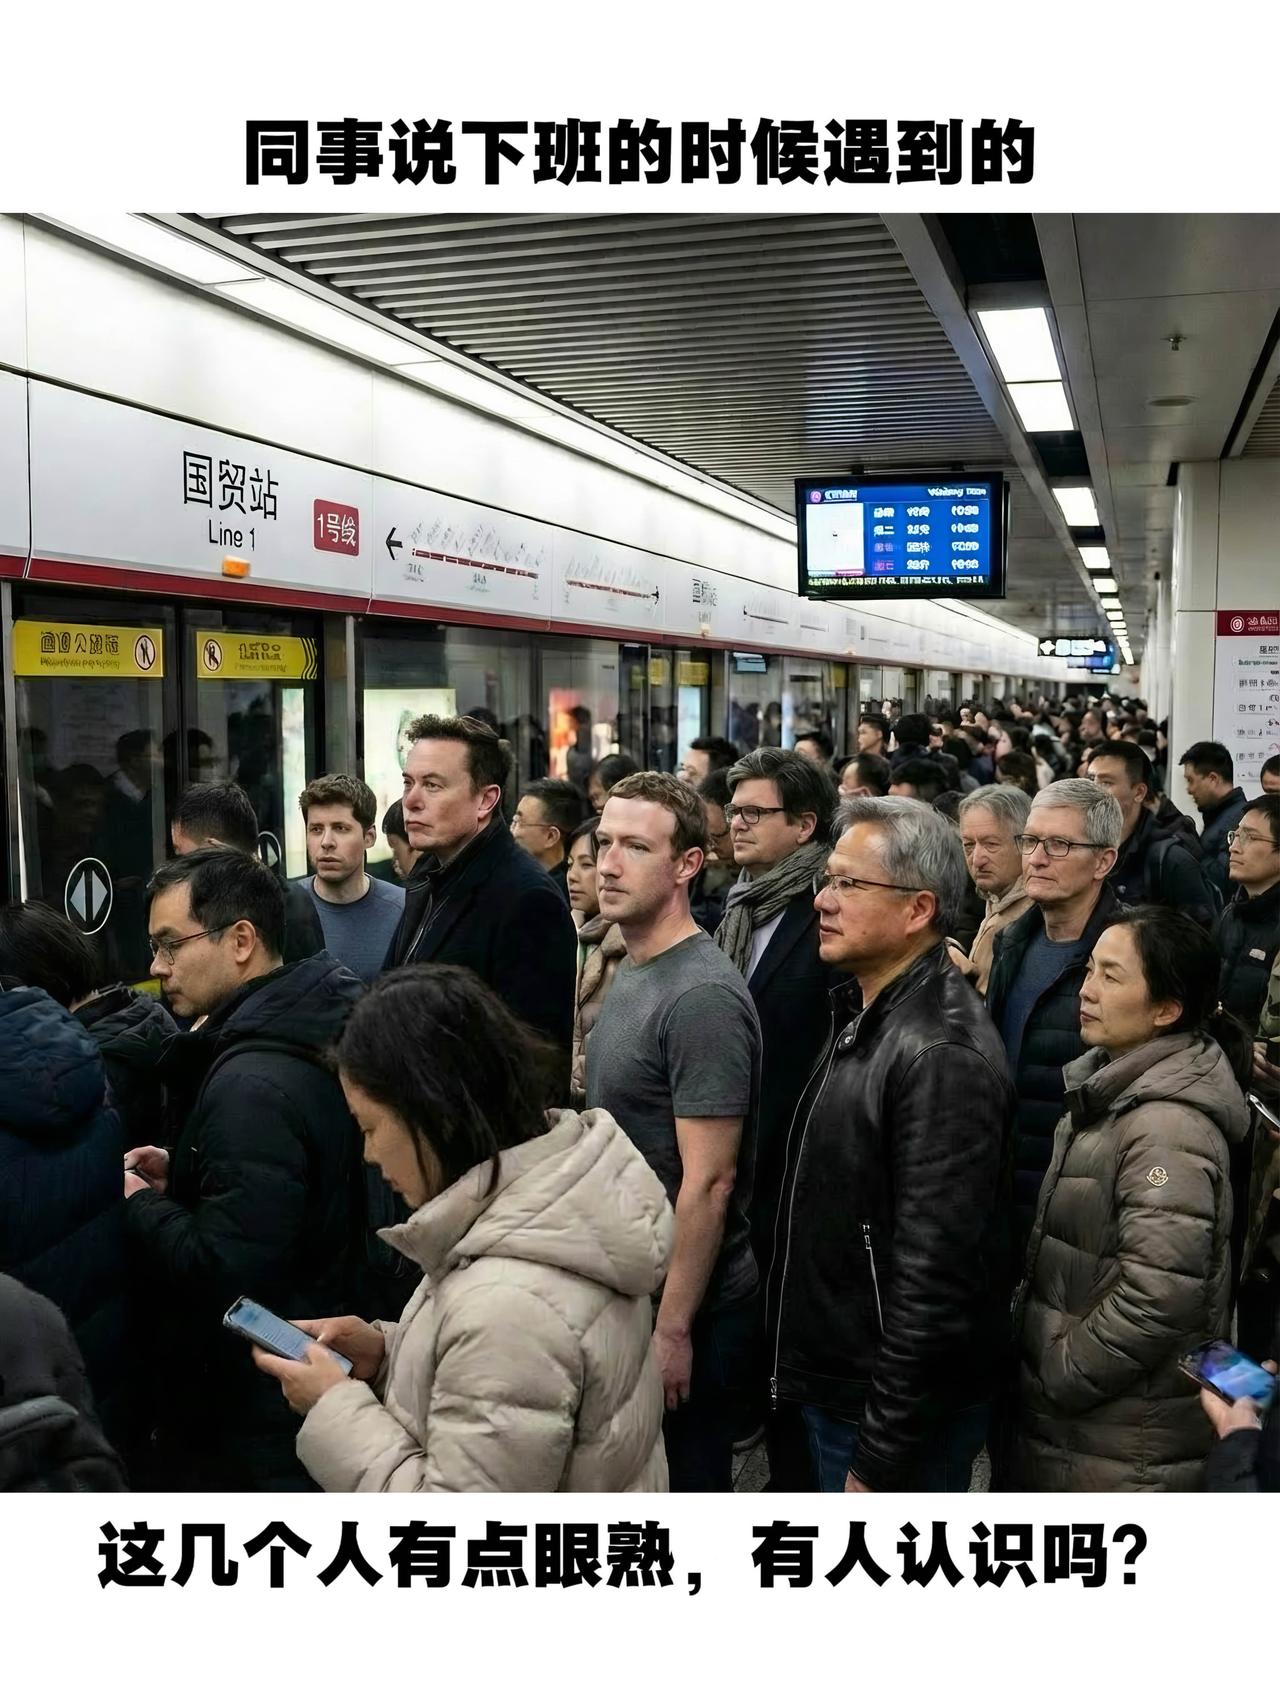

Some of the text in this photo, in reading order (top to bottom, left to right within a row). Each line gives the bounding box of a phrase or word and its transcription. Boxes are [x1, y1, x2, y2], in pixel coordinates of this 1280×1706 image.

[183, 450, 279, 521] 国贸站
[208, 519, 255, 551] Line 1
